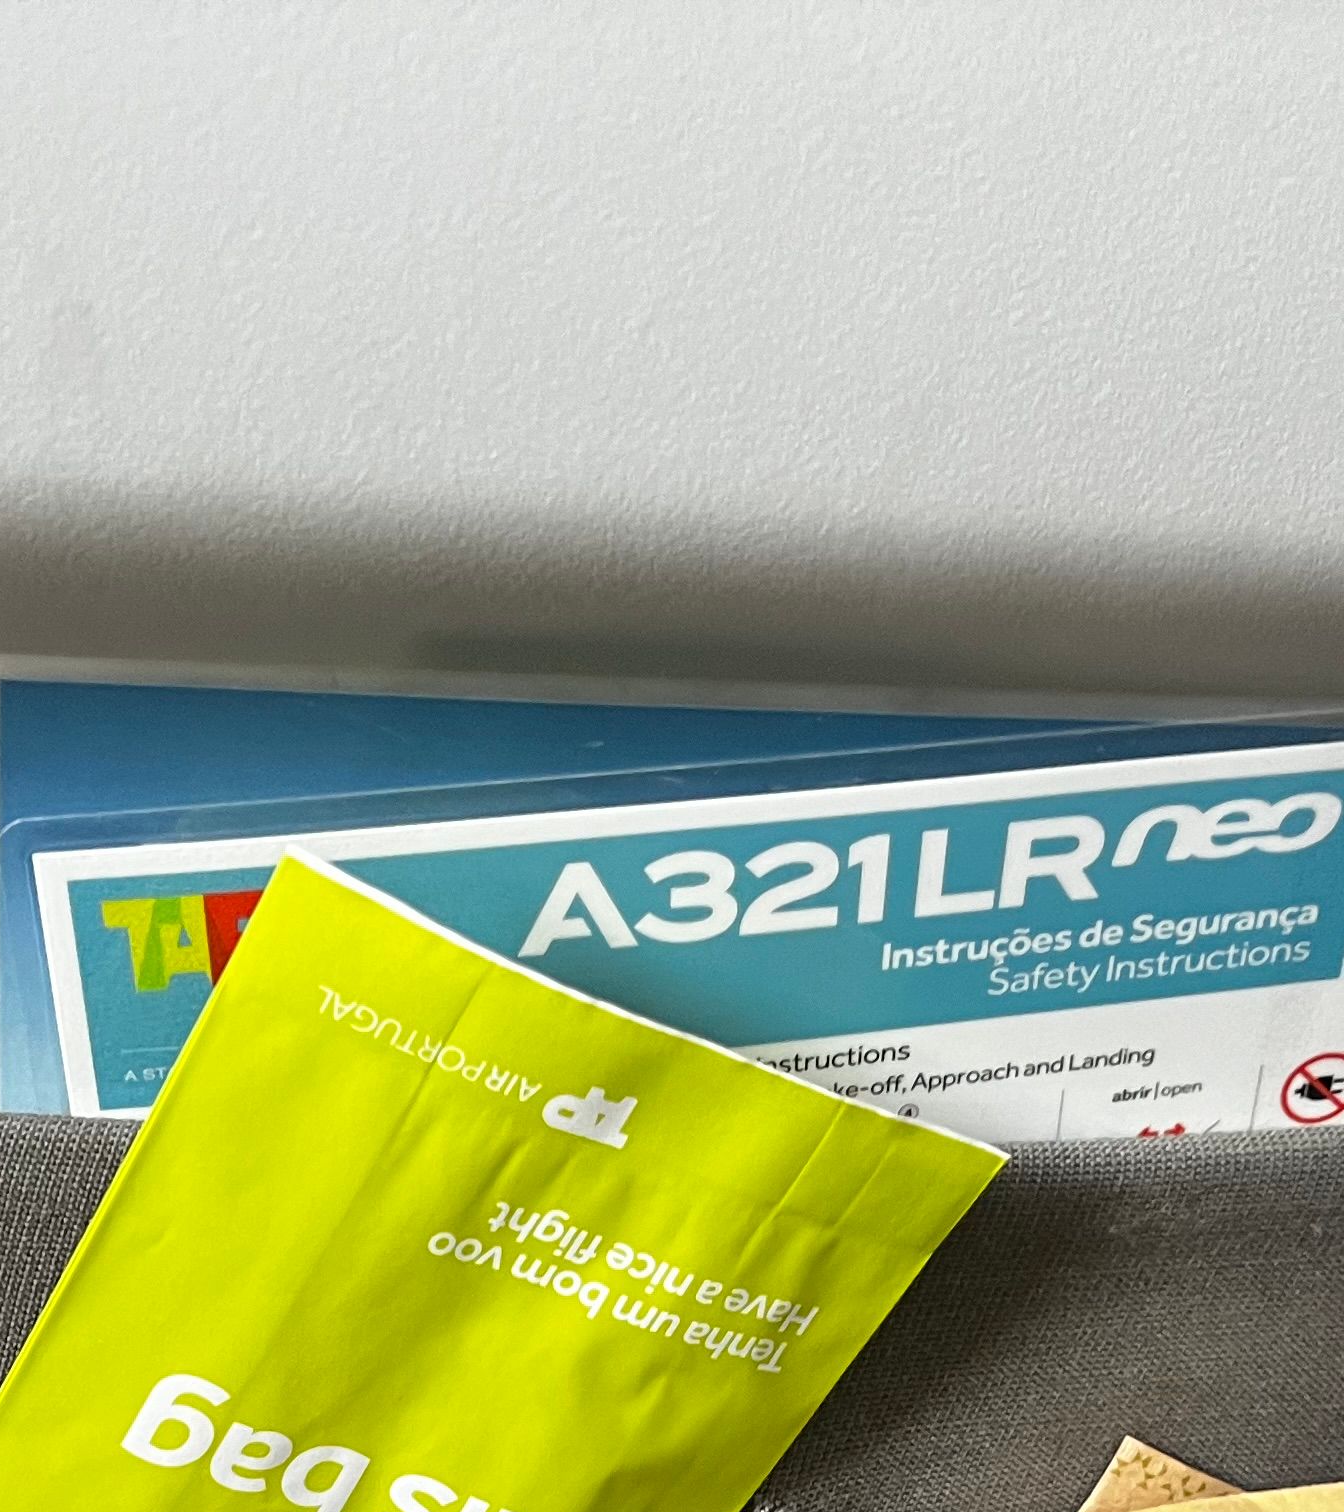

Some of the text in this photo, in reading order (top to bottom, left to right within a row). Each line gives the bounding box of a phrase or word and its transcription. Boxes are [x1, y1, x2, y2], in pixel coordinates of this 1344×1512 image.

[1111, 791, 1343, 868] neo
[881, 899, 1320, 973] Instruções de Segurança
[987, 936, 1311, 999] Safety Instructions
[756, 1044, 911, 1074] nstructions
[828, 1045, 1157, 1099] ke-off, Approach and Landing
[542, 1086, 638, 1149] TAP
[427, 1230, 789, 1374] Tenha um bom voo
[487, 1200, 820, 1337] Have a nice flight
